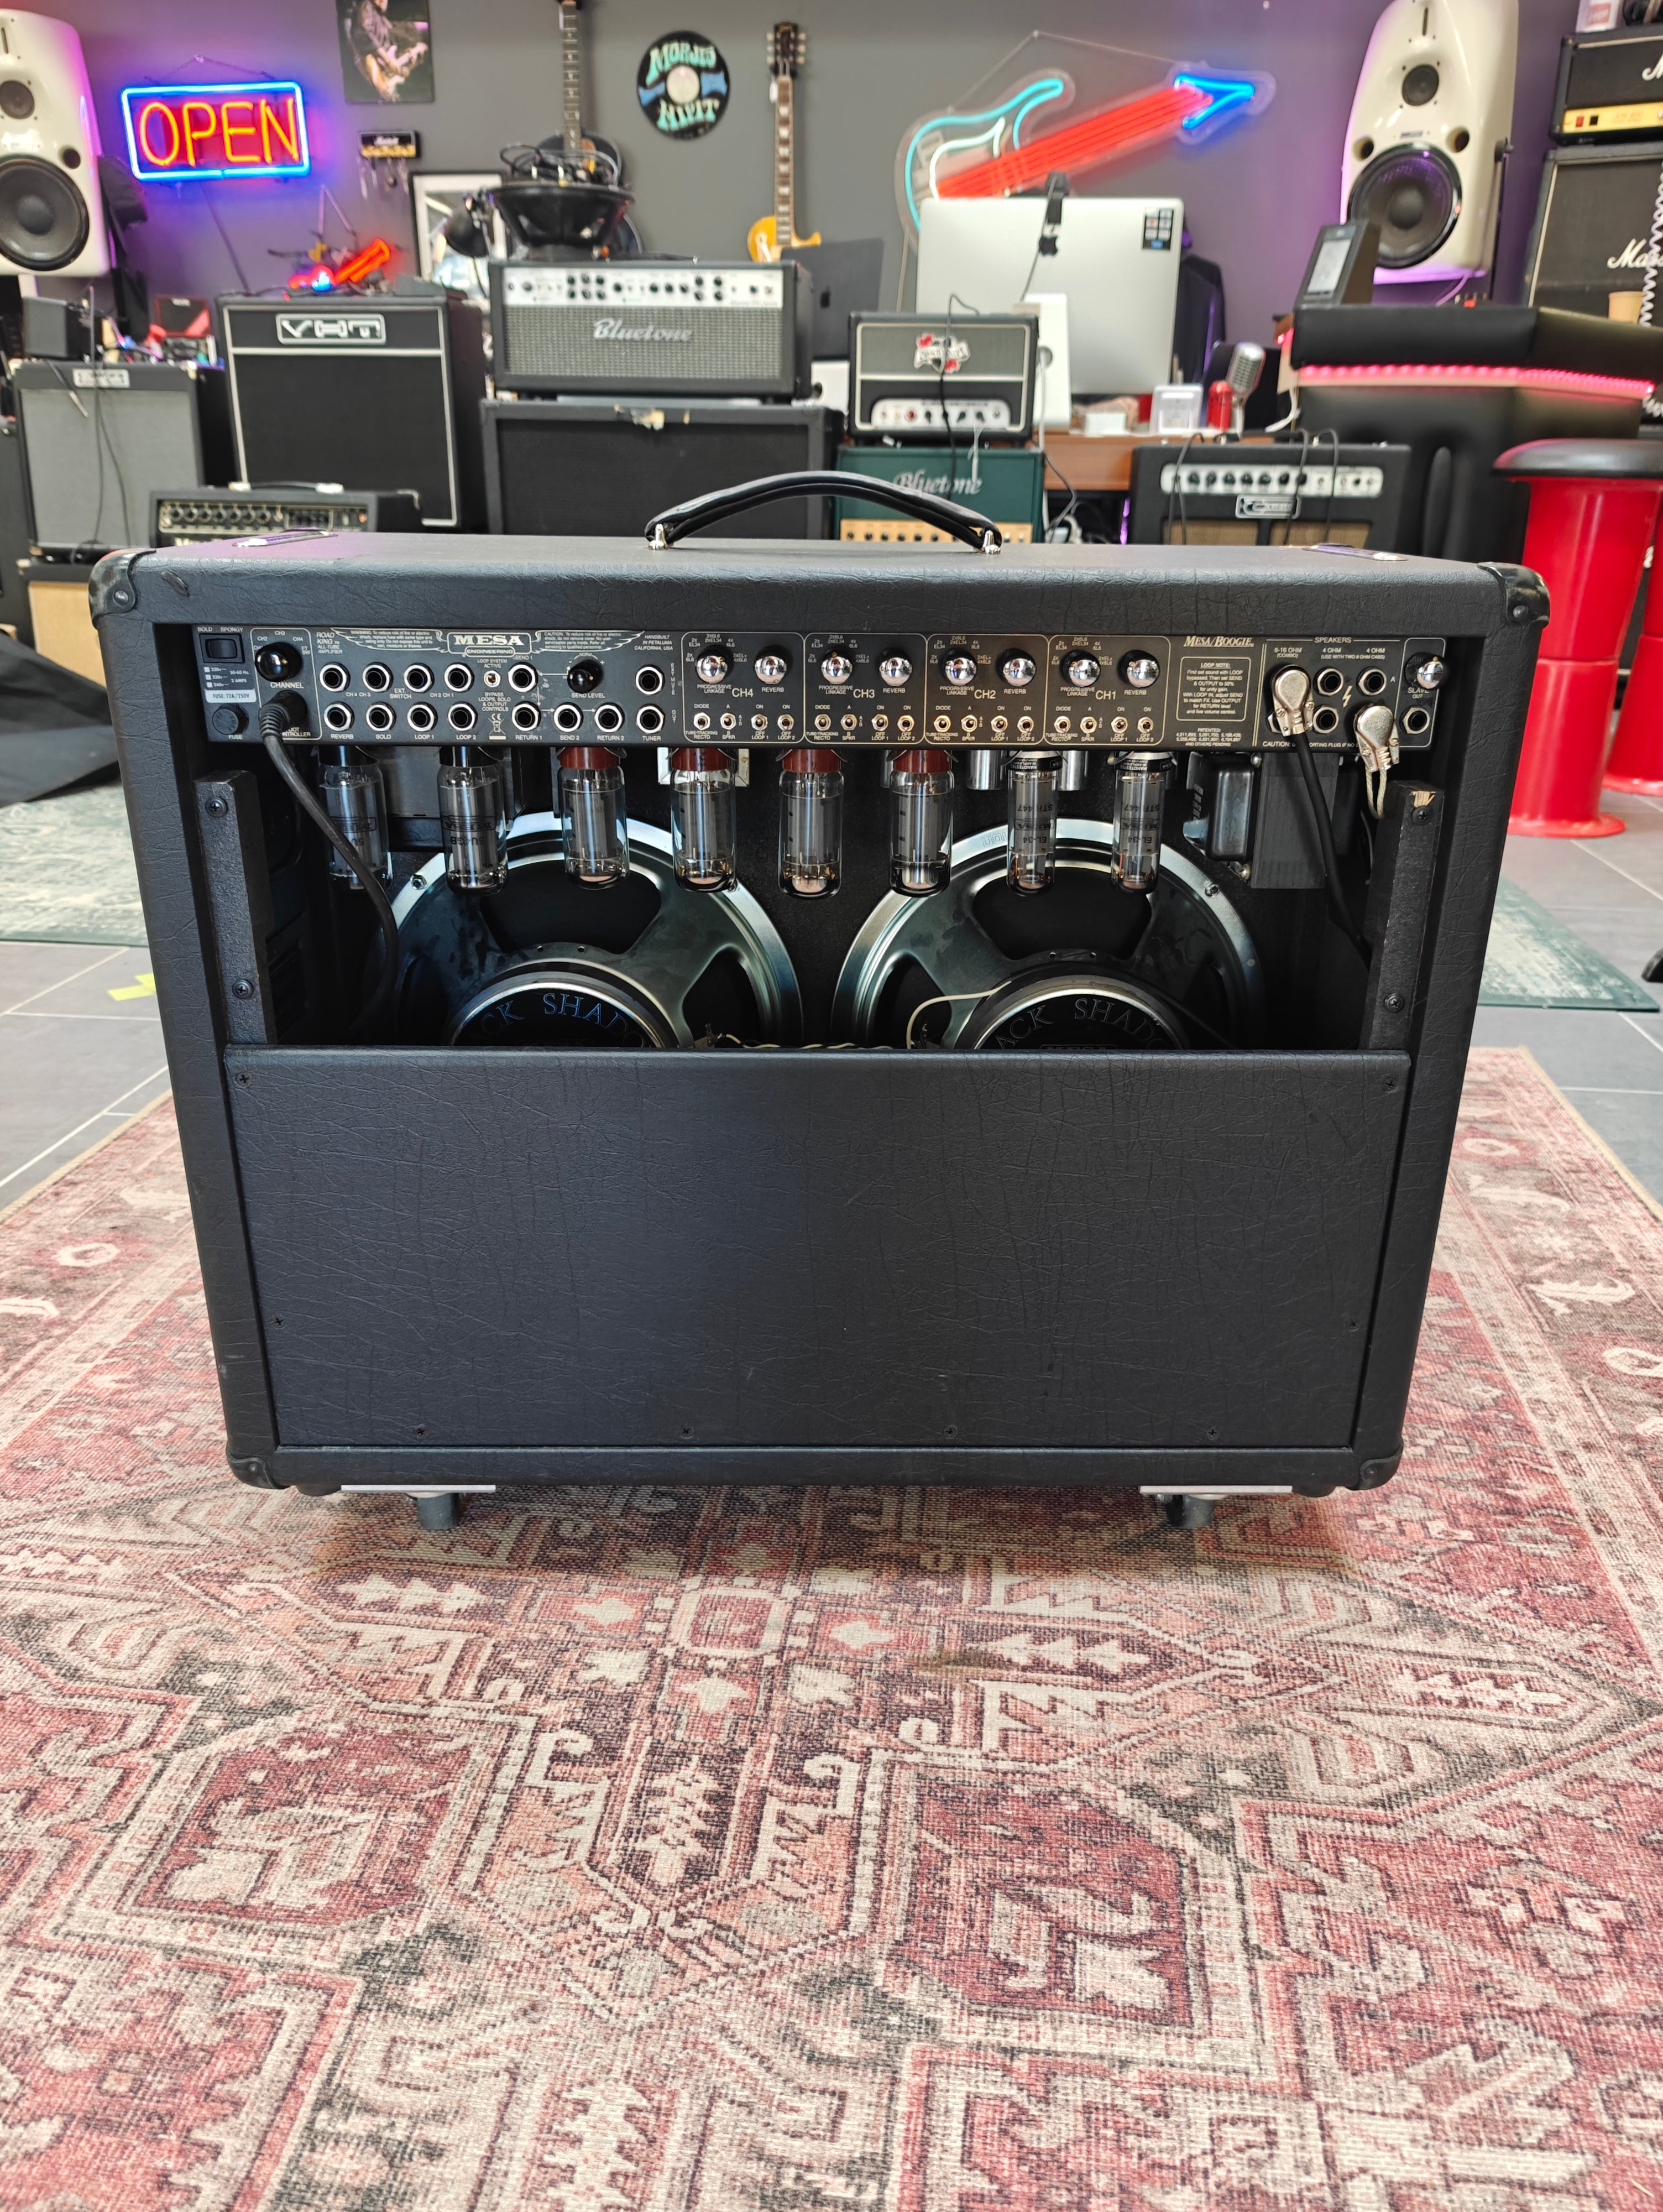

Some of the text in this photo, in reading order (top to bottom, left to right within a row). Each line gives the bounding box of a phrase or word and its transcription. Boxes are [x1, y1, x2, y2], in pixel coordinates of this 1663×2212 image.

[139, 97, 299, 167] OPEN
[280, 319, 382, 341] VHT
[593, 317, 692, 342] Bluetone
[893, 469, 983, 495] Bluetone
[453, 635, 525, 645] MESA
[1184, 636, 1252, 647] MESA/BOOGIE
[731, 688, 754, 697] CH4
[853, 690, 875, 698] CH3
[974, 690, 996, 699] CH2
[1095, 691, 1116, 700] CH1
[542, 993, 646, 1047] SHADO
[996, 1004, 1054, 1049] ACK
